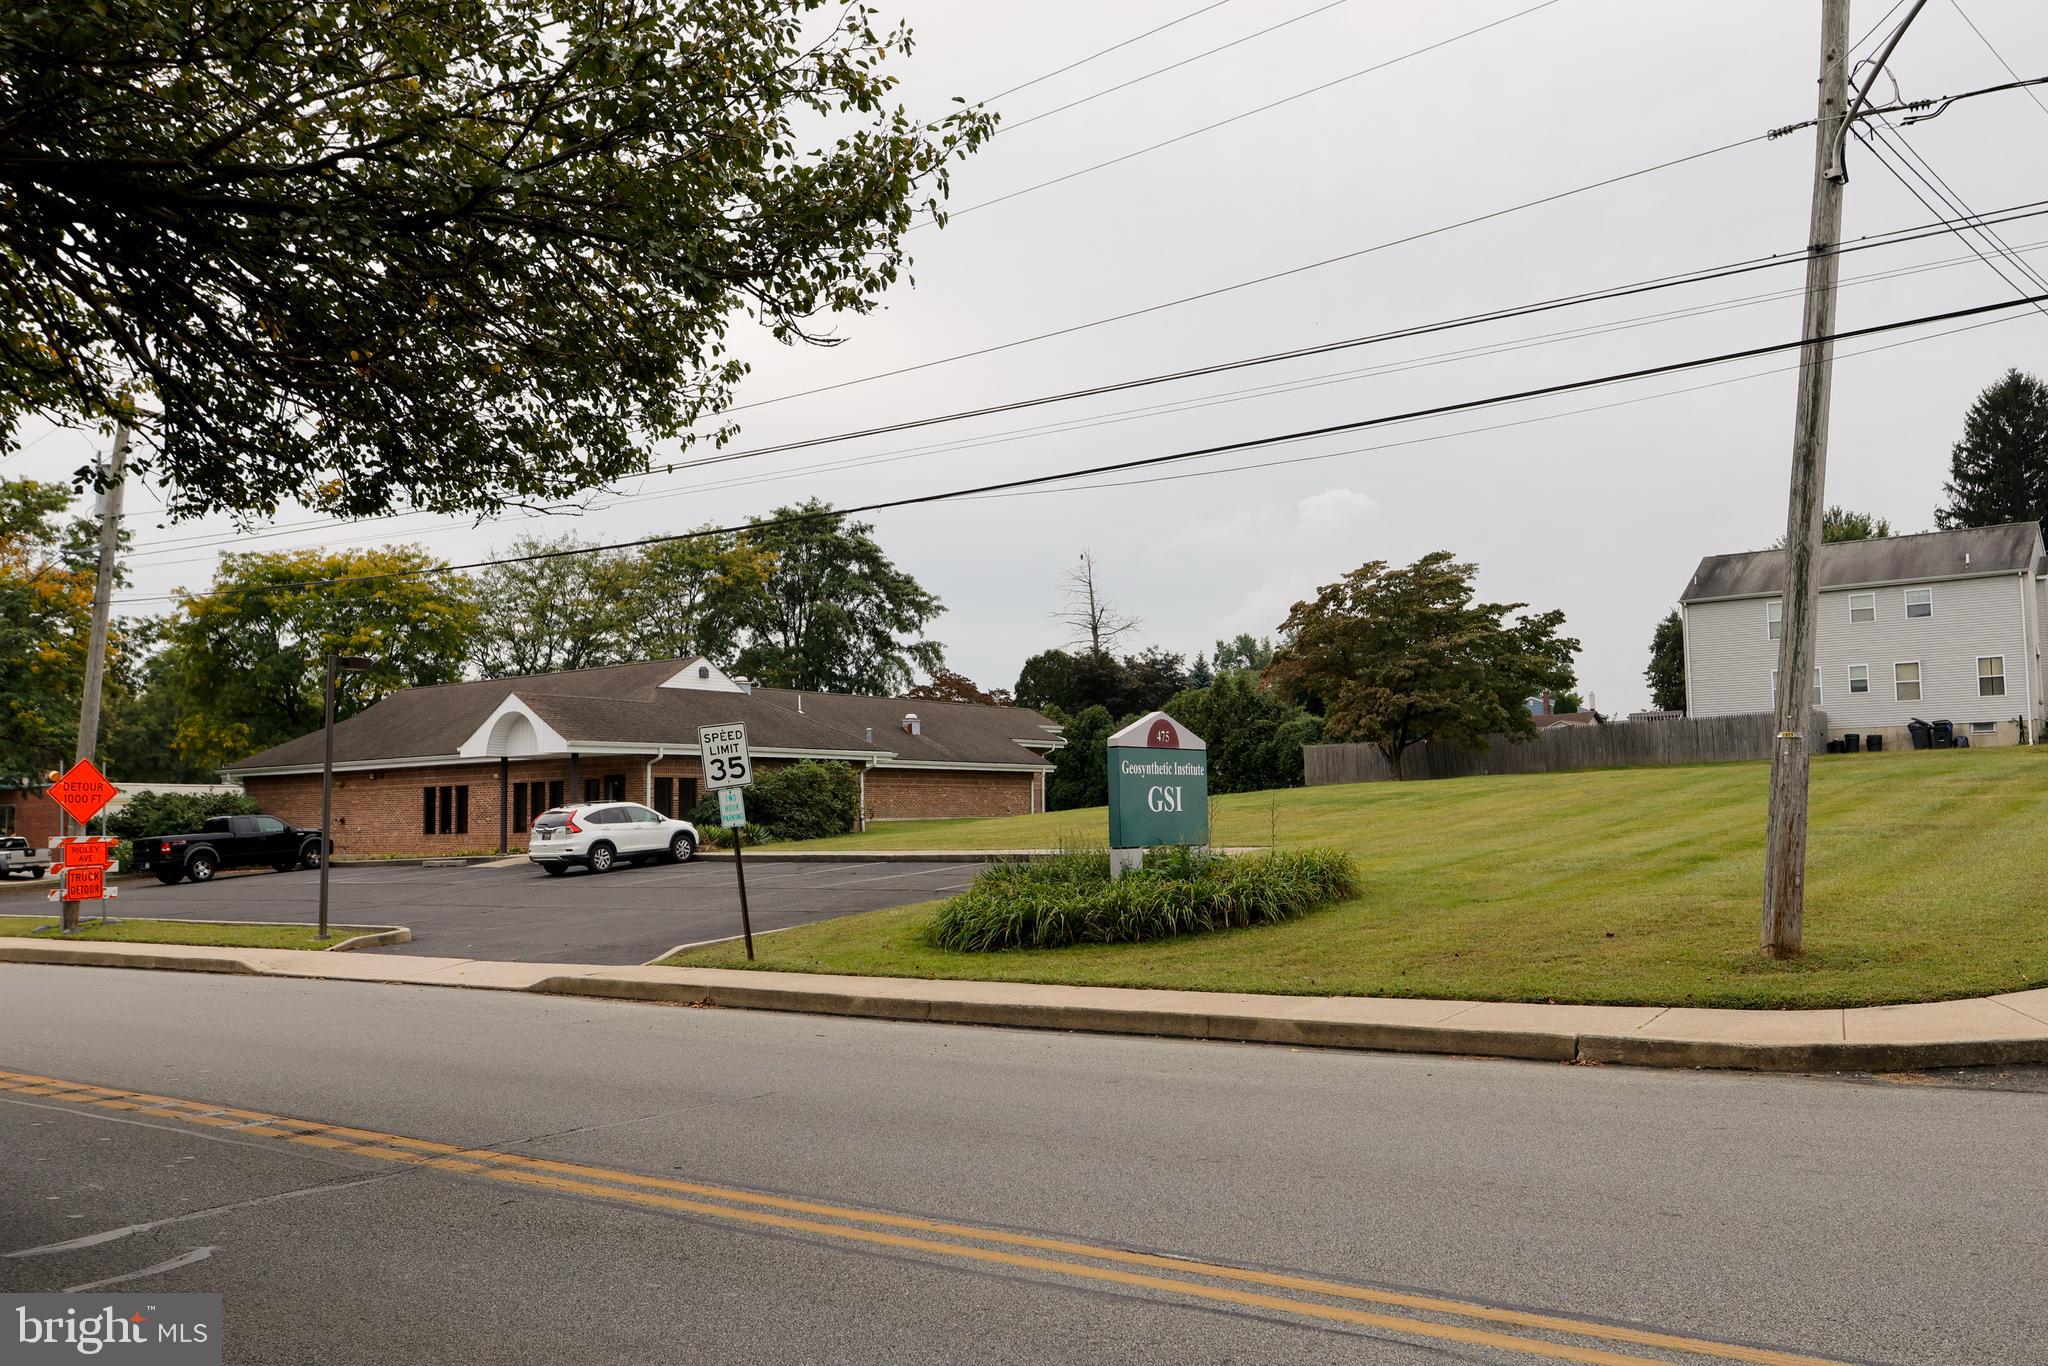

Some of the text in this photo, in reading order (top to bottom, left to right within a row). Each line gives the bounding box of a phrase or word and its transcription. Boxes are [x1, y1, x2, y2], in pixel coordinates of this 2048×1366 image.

[704, 730, 743, 743] SPEED
[1156, 730, 1170, 742] 475
[709, 743, 739, 756] LIMIT
[710, 756, 746, 781] 35
[1121, 760, 1205, 778] Geosynthetic Institute
[63, 782, 104, 792] DETOUR
[64, 794, 102, 804] 1000 FT
[1147, 785, 1184, 813] GSI
[71, 846, 100, 854] RIDLEY
[78, 855, 94, 863] AVE
[71, 872, 100, 883] TRUCK
[70, 884, 100, 895] DETOUR
